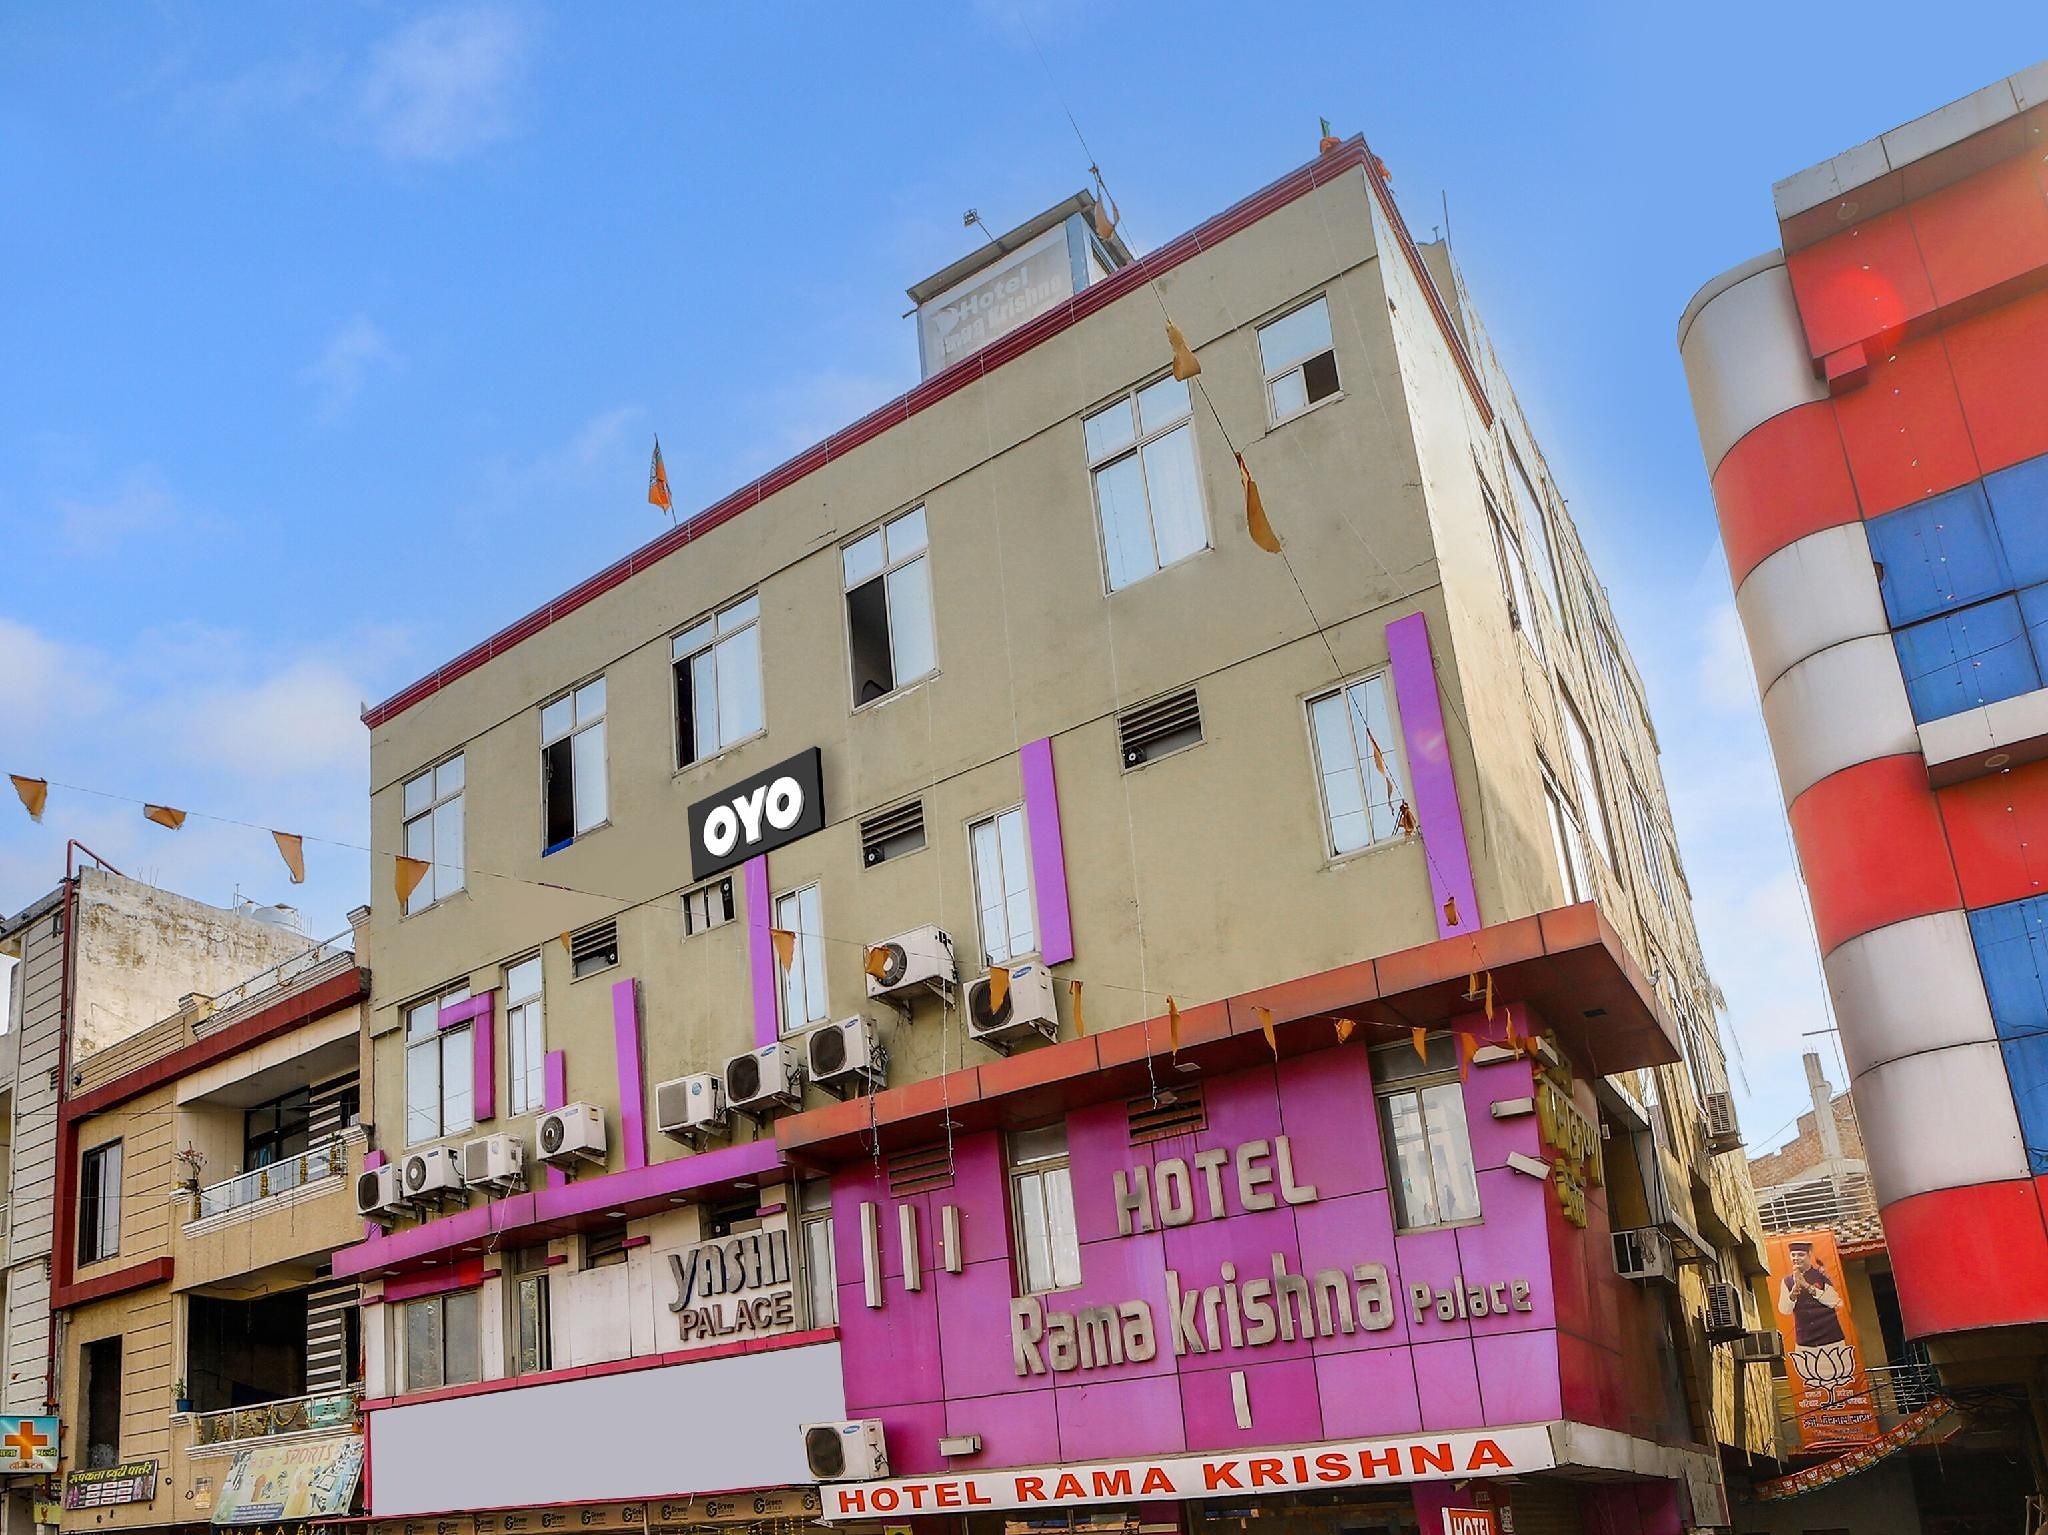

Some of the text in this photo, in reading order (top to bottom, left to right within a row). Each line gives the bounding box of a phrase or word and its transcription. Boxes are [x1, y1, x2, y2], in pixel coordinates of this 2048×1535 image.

[959, 266, 1029, 319] Hotel
[703, 776, 804, 857] OYO
[1112, 1135, 1319, 1236] HOTEL
[668, 1229, 790, 1312] YASHI
[678, 1290, 793, 1341] PALACE
[1009, 1252, 1533, 1376] Rama krishna Palace
[283, 1443, 334, 1465] SPORTS
[838, 1439, 1513, 1513] HOTEL RAMA KRISHNA
